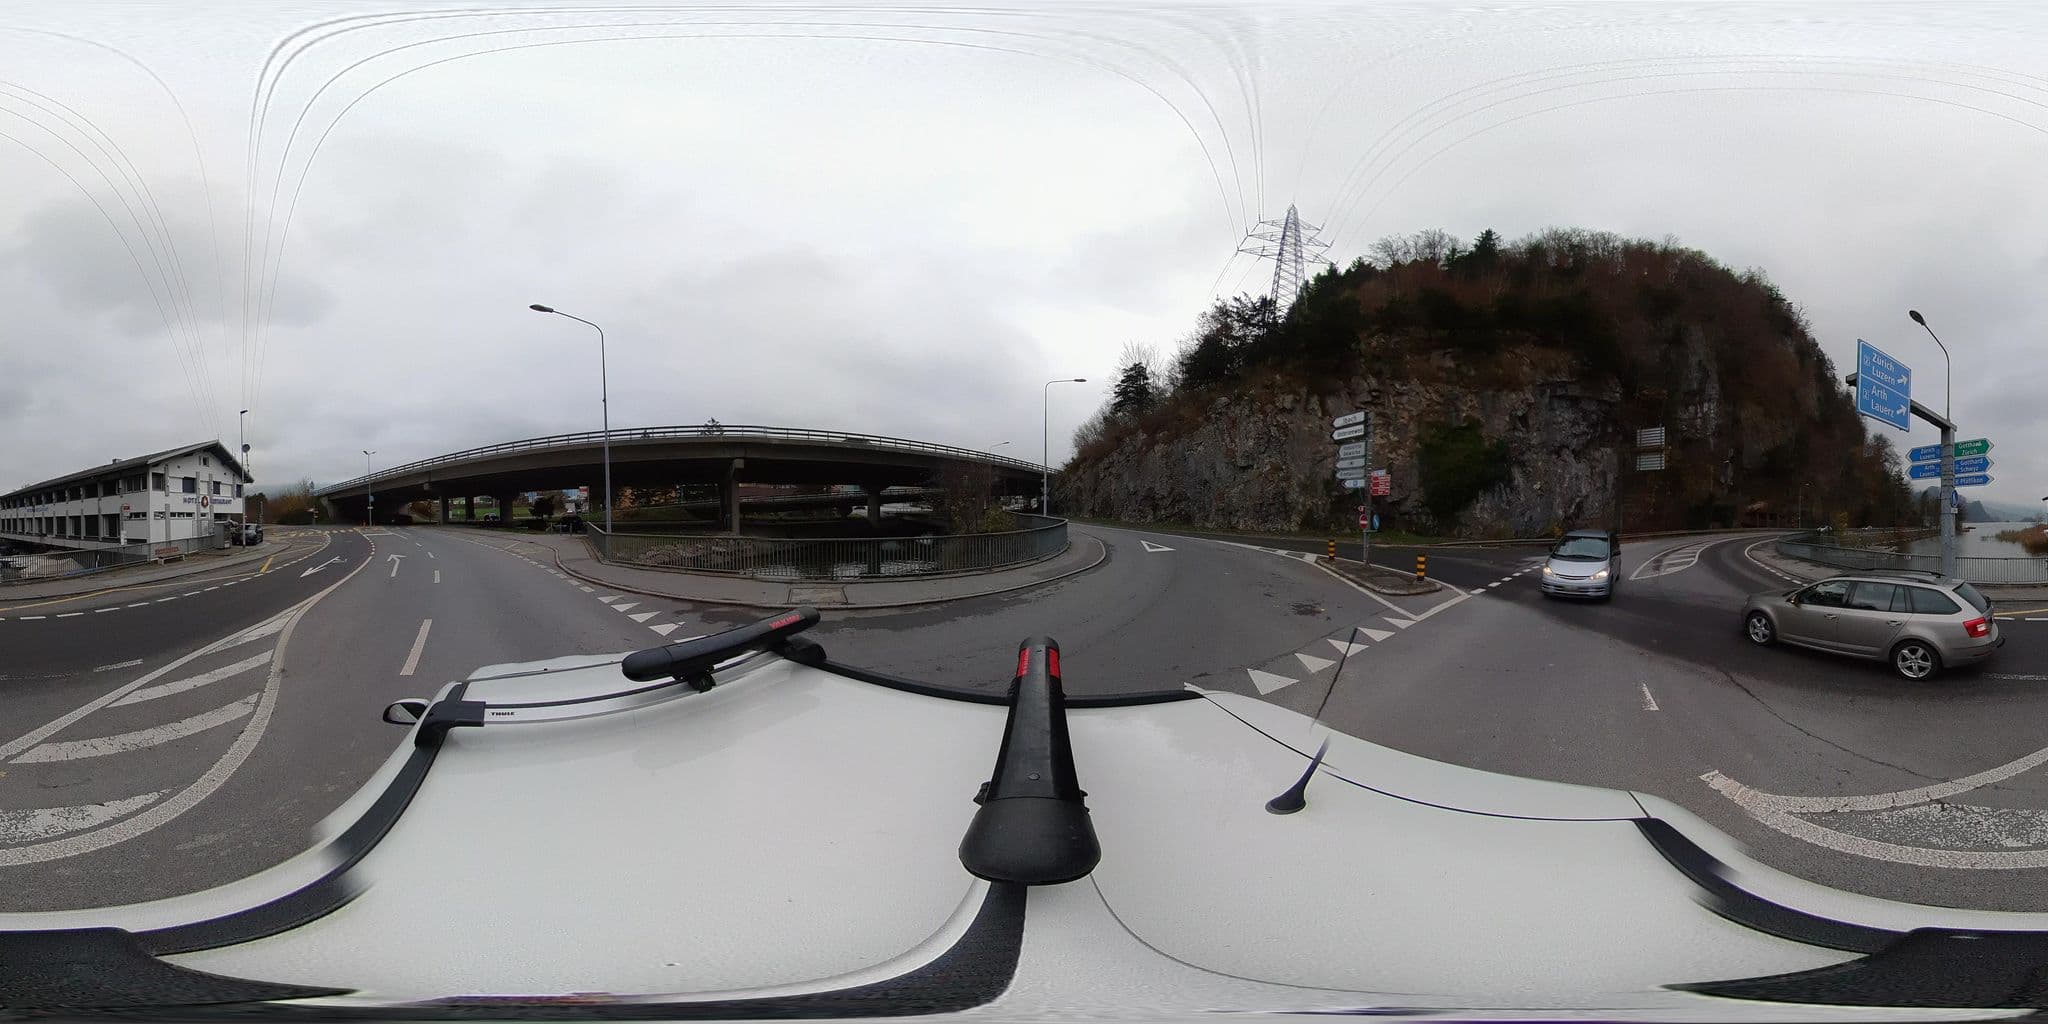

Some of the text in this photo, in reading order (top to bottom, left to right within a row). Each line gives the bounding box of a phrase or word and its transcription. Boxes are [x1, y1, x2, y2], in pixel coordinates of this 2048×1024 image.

[1872, 352, 1894, 372] Zürich
[1872, 366, 1896, 385] Luzern
[1871, 385, 1888, 401] Arth
[1871, 400, 1894, 418] Lauerz
